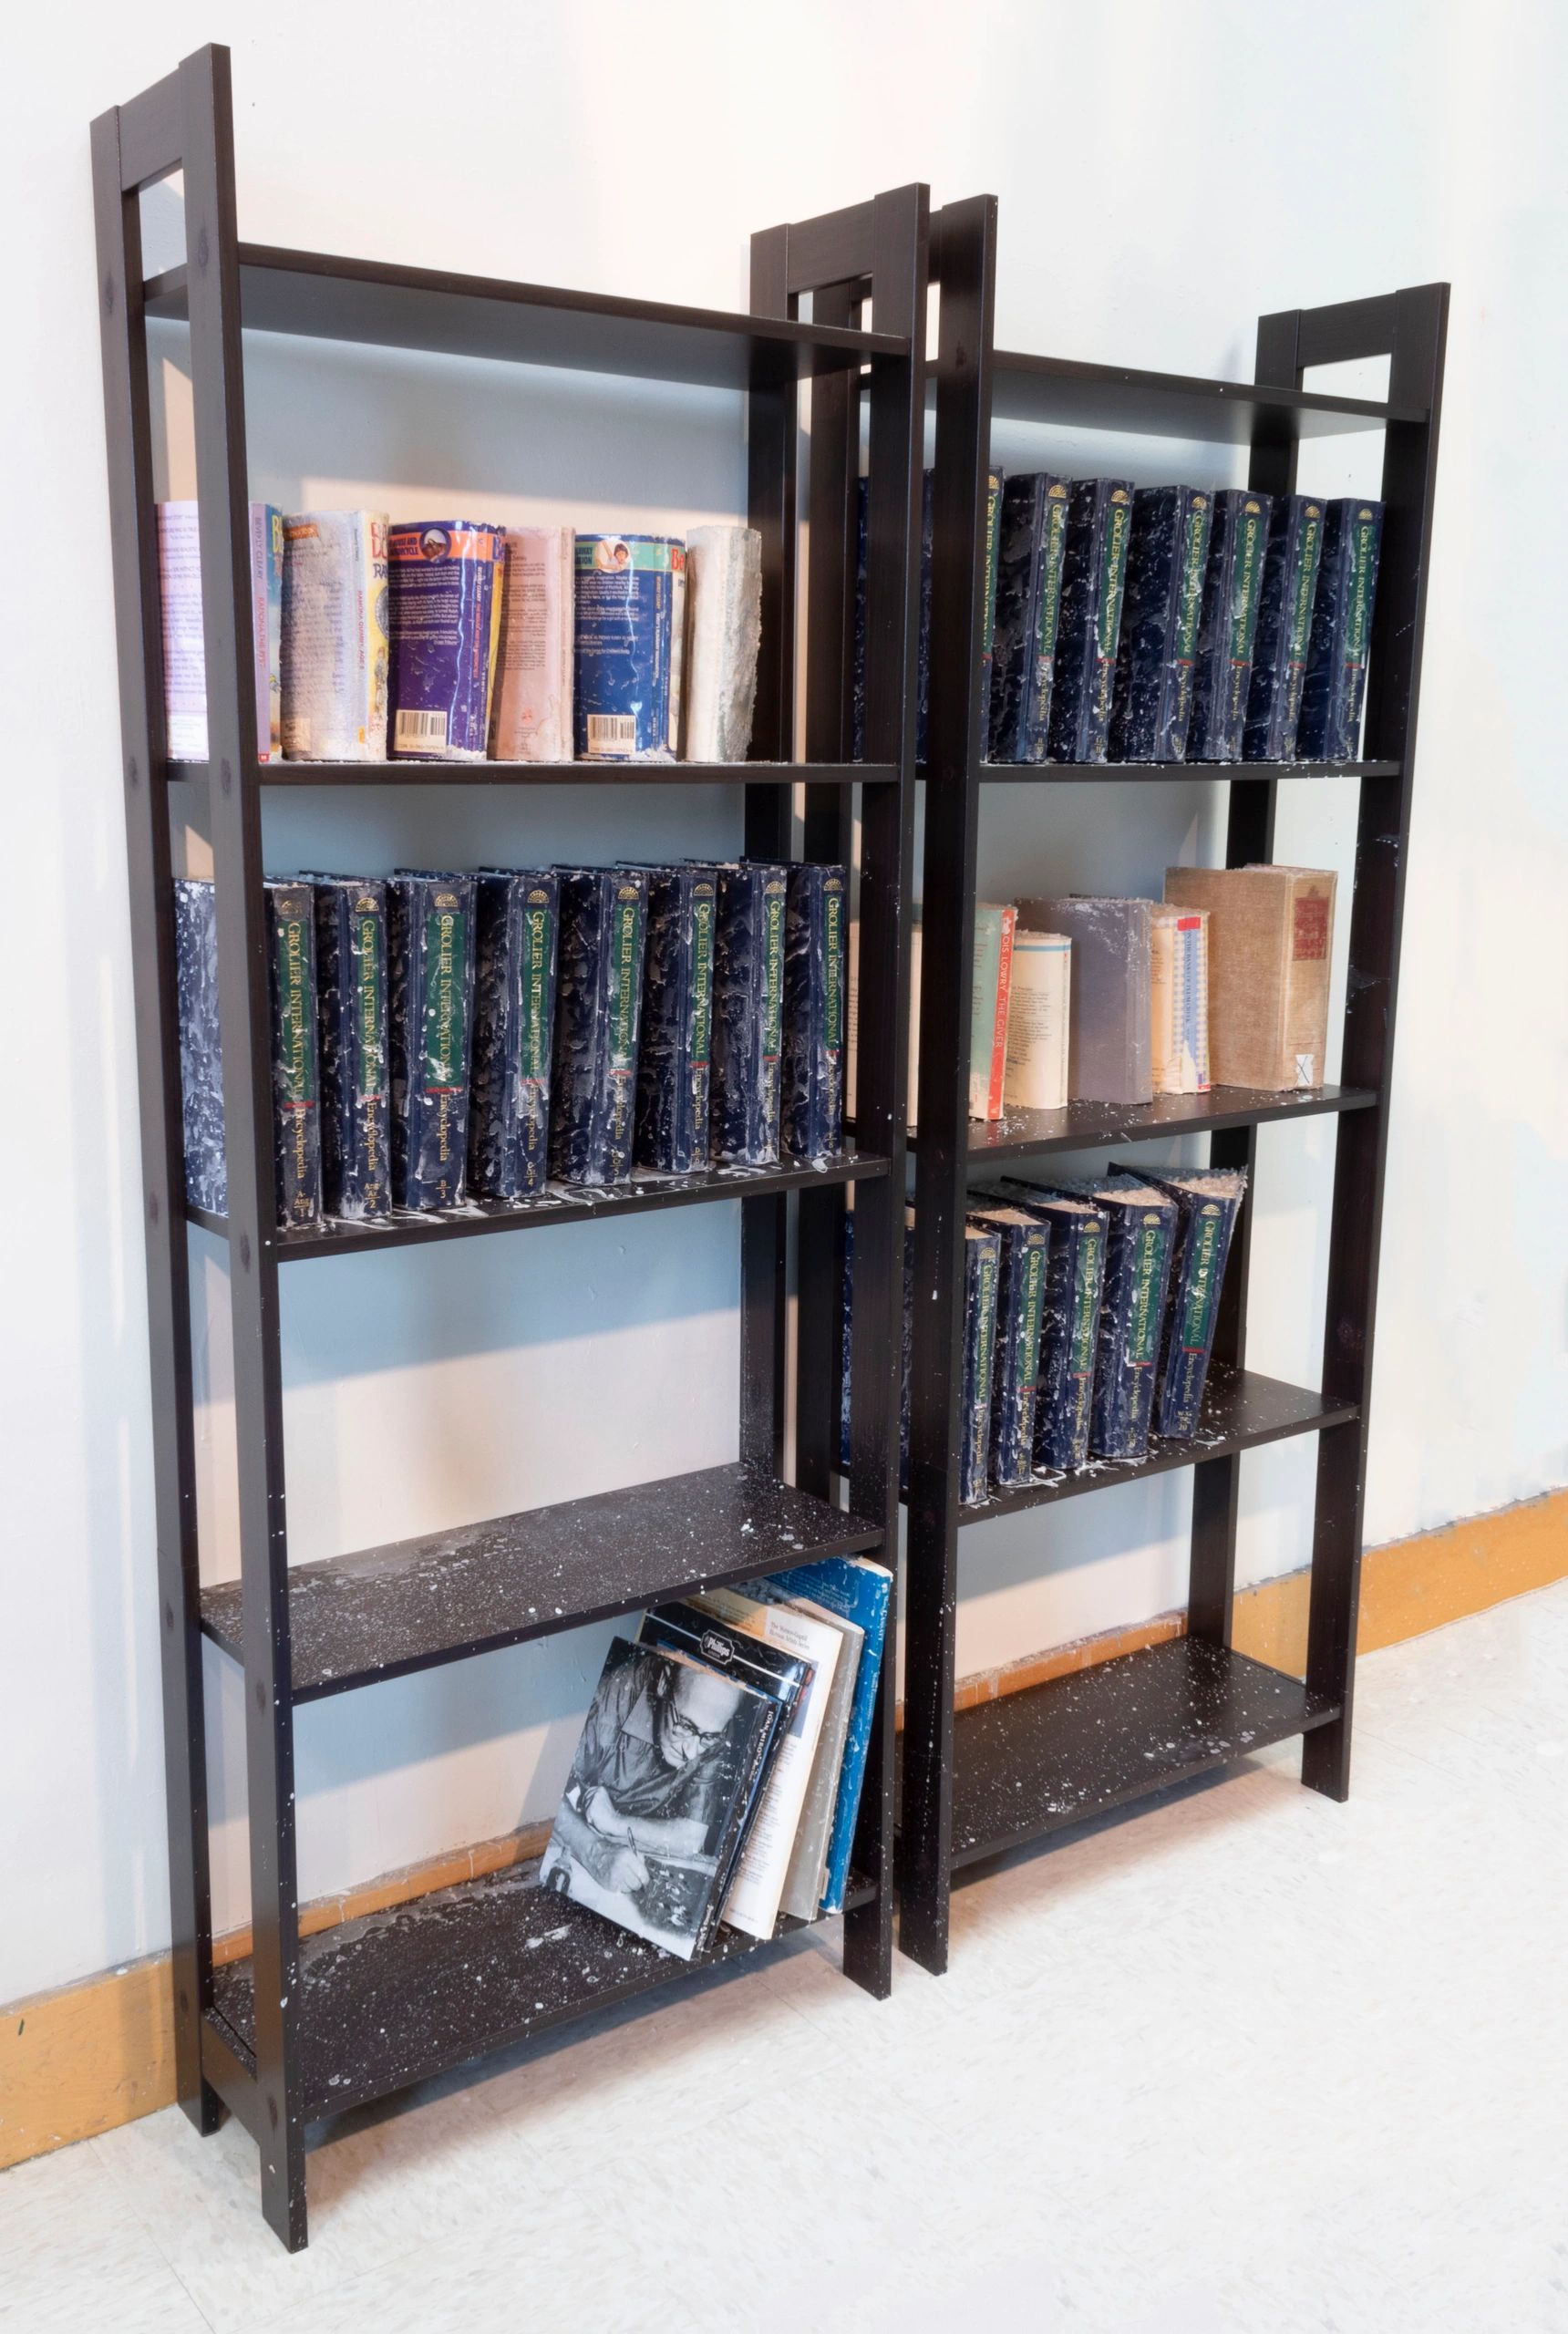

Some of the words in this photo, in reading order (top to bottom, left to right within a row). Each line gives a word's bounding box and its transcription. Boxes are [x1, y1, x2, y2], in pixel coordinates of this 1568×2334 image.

[1048, 503, 1062, 556] GROLIER
[1111, 509, 1125, 560] GROLIER
[1191, 516, 1203, 566] GROLIER
[1243, 519, 1256, 569] GROLIER
[1304, 523, 1315, 573] GROLIER
[1357, 526, 1370, 573] GROLIER
[255, 549, 263, 580] CLEARY
[256, 597, 265, 633] RAMONA
[1043, 559, 1059, 654] INTERNATIONAL
[1103, 563, 1119, 653] INTERNATIONAL
[1182, 568, 1200, 654] INTERNATIONAL
[1236, 571, 1252, 656] INTERNATIONAL
[1295, 575, 1311, 657] INTERNATIONAL
[1351, 577, 1366, 657] INTERNATIONAL
[1097, 663, 1109, 722] Encyclopedia
[1177, 666, 1189, 722] Encyclopedia
[1232, 666, 1243, 721] Encyclopedia
[1287, 667, 1299, 722] Encyclopedia
[1347, 668, 1358, 722] Encyclopedia
[360, 919, 375, 981] GROLIER
[439, 914, 454, 974] GROLIER
[532, 911, 545, 968] GROLIER
[621, 907, 635, 964] GROLIER
[697, 903, 711, 959] GROLIER
[769, 900, 781, 955] GROLIER
[827, 897, 839, 951] GROLIER
[1001, 935, 1010, 953] OIS
[288, 921, 303, 986] GROLIER
[999, 956, 1008, 992] LOWRY
[530, 974, 542, 1075] INTERNATIONAL
[618, 968, 632, 1067] INTERNATIONA
[696, 962, 707, 1058] INTERNATIONAL
[768, 958, 779, 1051] INTERNATIONAL
[827, 955, 838, 1045] INTERNATIONAL
[997, 996, 1006, 1016] THE
[290, 989, 304, 1096] INTERNATIONAL
[440, 978, 452, 1081] INTERNATION
[995, 1018, 1004, 1048] GIVER
[614, 1076, 627, 1140] Encyclopedia
[693, 1068, 704, 1130] Encyclopedia
[765, 1061, 776, 1123] Encyclopedia
[826, 1058, 838, 1115] ncyclopedia
[294, 1108, 307, 1178] Encyclopedia
[366, 1102, 378, 1172] Encyclopedia
[438, 1093, 450, 1162] Encyclopedia
[527, 1085, 539, 1151] Encyclopedia
[369, 1199, 377, 1209] 2
[1086, 1238, 1098, 1285] GROLIER
[1142, 1230, 1156, 1275] GROLIER
[1200, 1220, 1216, 1265] GROLIER
[981, 1265, 992, 1315] GROLIER
[1028, 1250, 1041, 1298] GROLIER
[1078, 1286, 1093, 1368] INTERNATIONAL
[1135, 1278, 1150, 1359] INTERNATIONAL
[1189, 1268, 1209, 1346] TERNATIONAL
[977, 1317, 988, 1399] INTERNATIONAL
[1024, 1301, 1037, 1383] INTERNATIONAL
[1075, 1377, 1087, 1430] Encyclopedia
[1130, 1367, 1142, 1420] Encyclopedia
[1181, 1352, 1198, 1403] Encyclopedia
[975, 1409, 986, 1465] Encyclopedia
[1019, 1391, 1031, 1446] Encyclopedia
[707, 1636, 730, 1657] Phillips
[763, 1710, 774, 1731] JOAN
